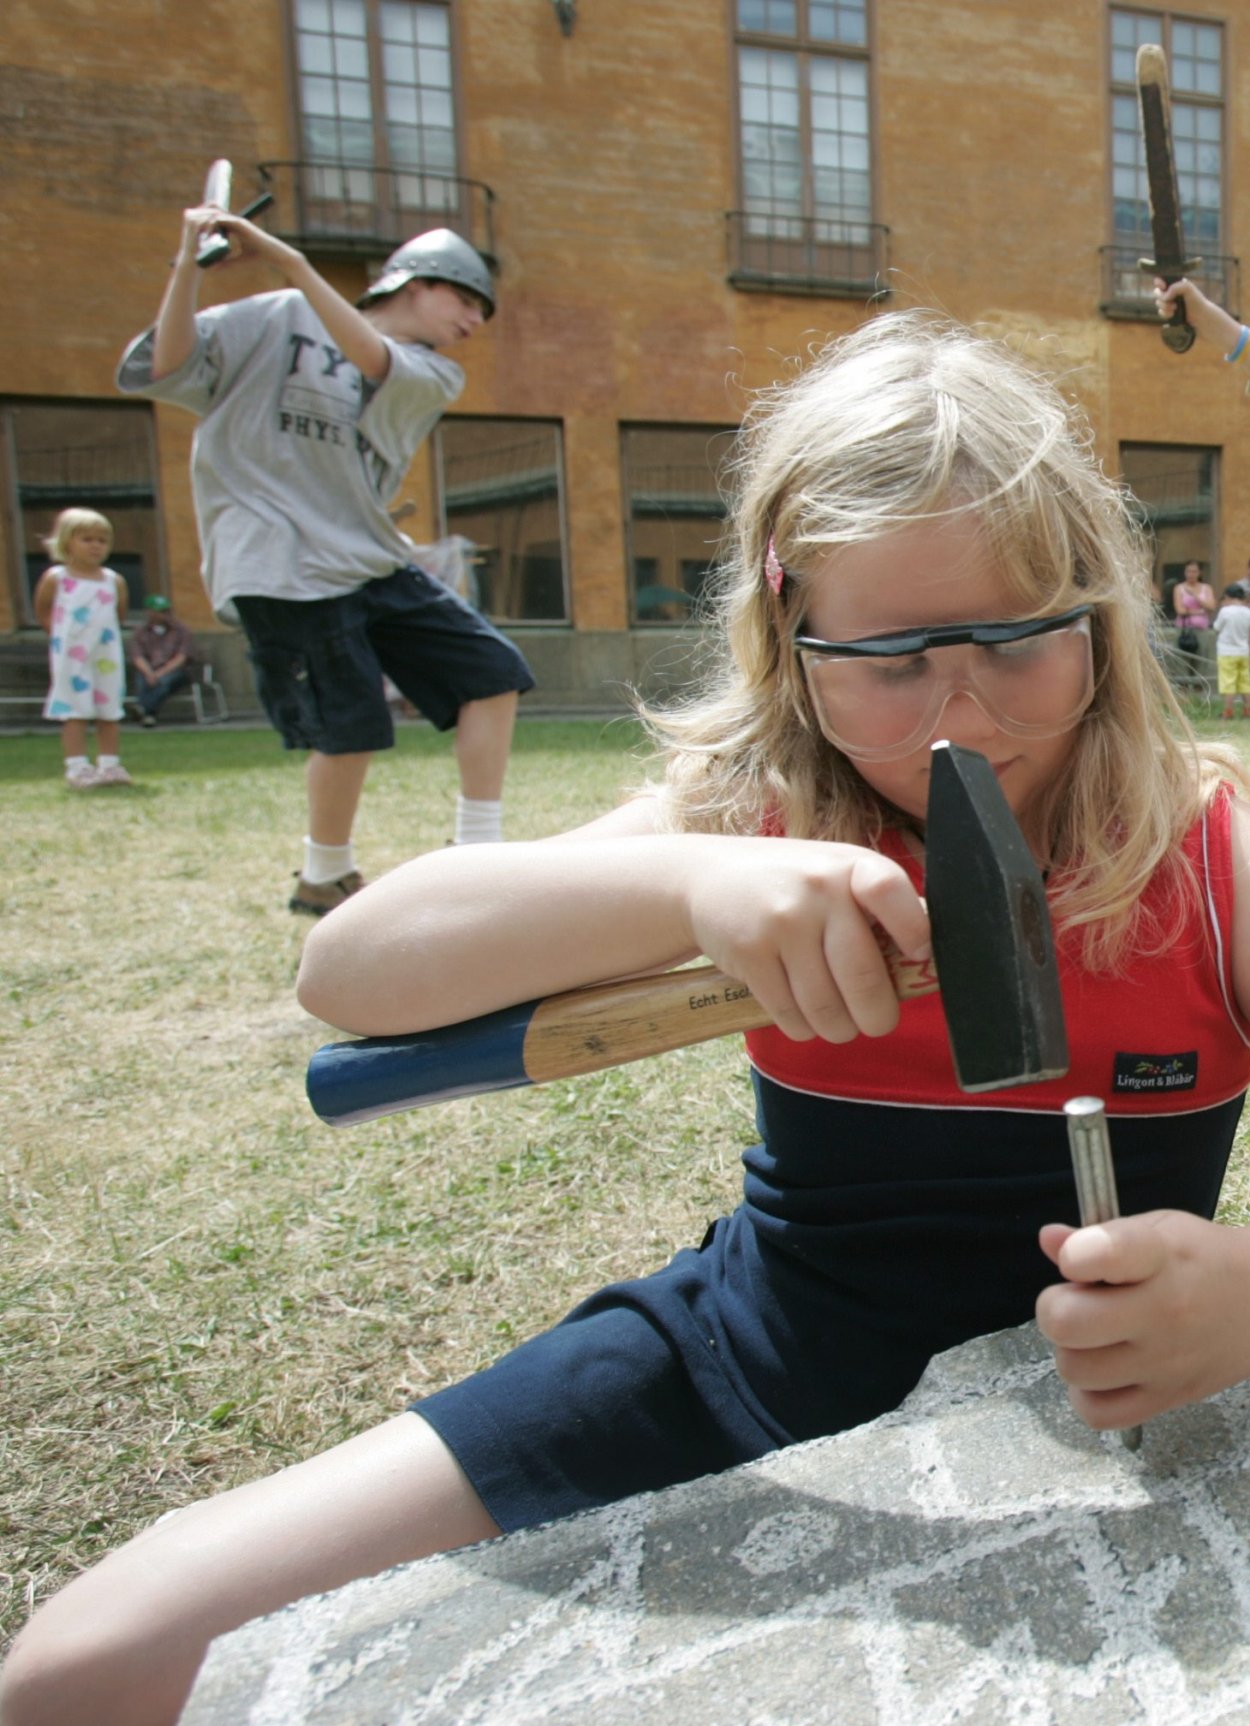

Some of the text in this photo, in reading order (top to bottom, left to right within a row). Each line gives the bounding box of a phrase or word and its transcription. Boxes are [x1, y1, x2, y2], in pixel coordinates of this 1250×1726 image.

[688, 992, 719, 1010] Echt
[1116, 1073, 1155, 1089] Lingon
[1156, 1076, 1164, 1087] &
